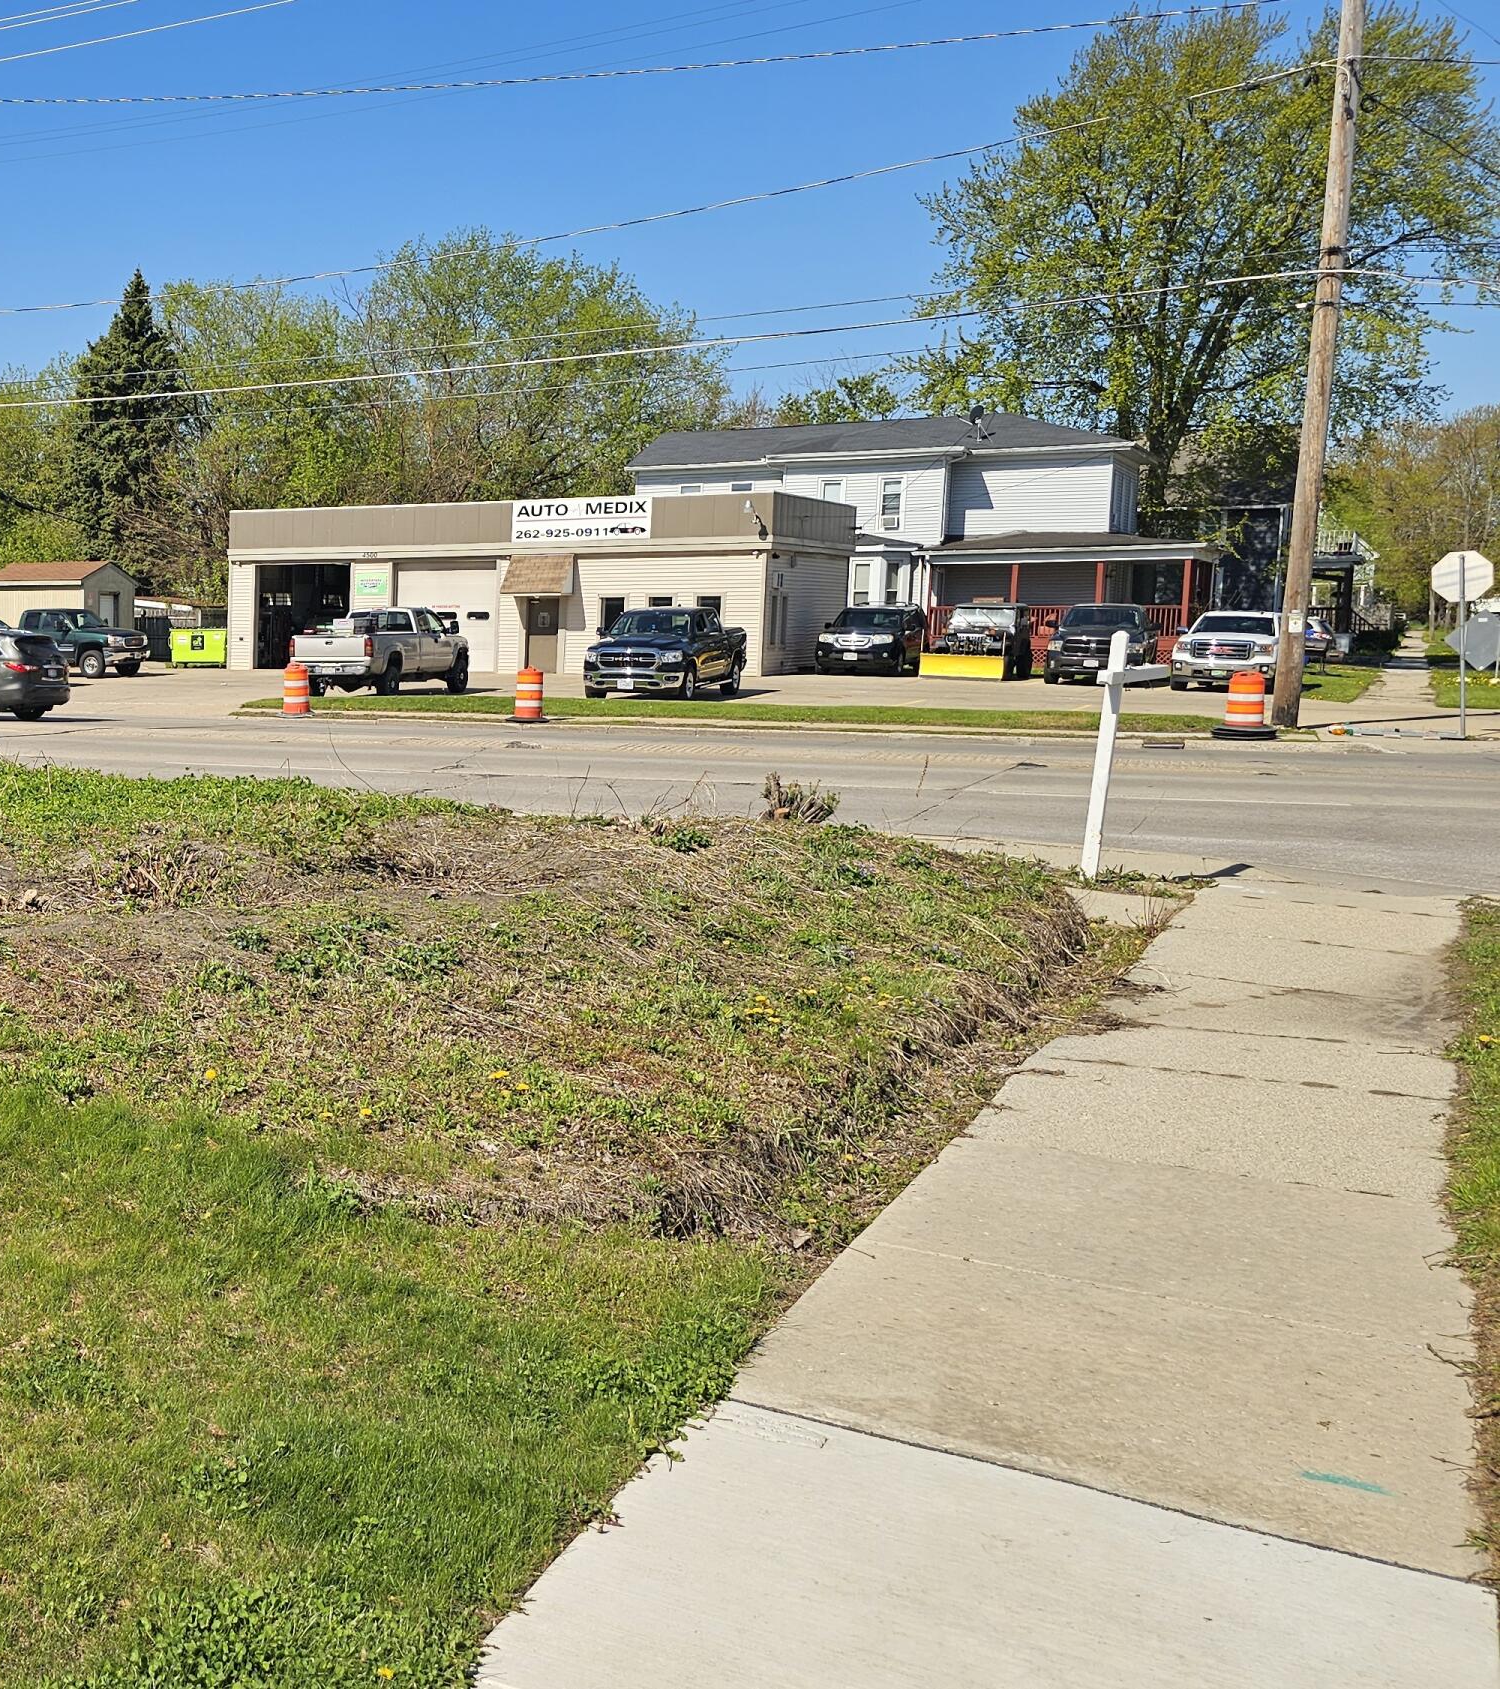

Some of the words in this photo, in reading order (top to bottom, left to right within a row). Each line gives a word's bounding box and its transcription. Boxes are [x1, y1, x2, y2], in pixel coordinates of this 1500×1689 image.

[517, 504, 568, 517] AUTO
[585, 501, 647, 515] MEDIX
[516, 527, 609, 539] 262-925-0911
